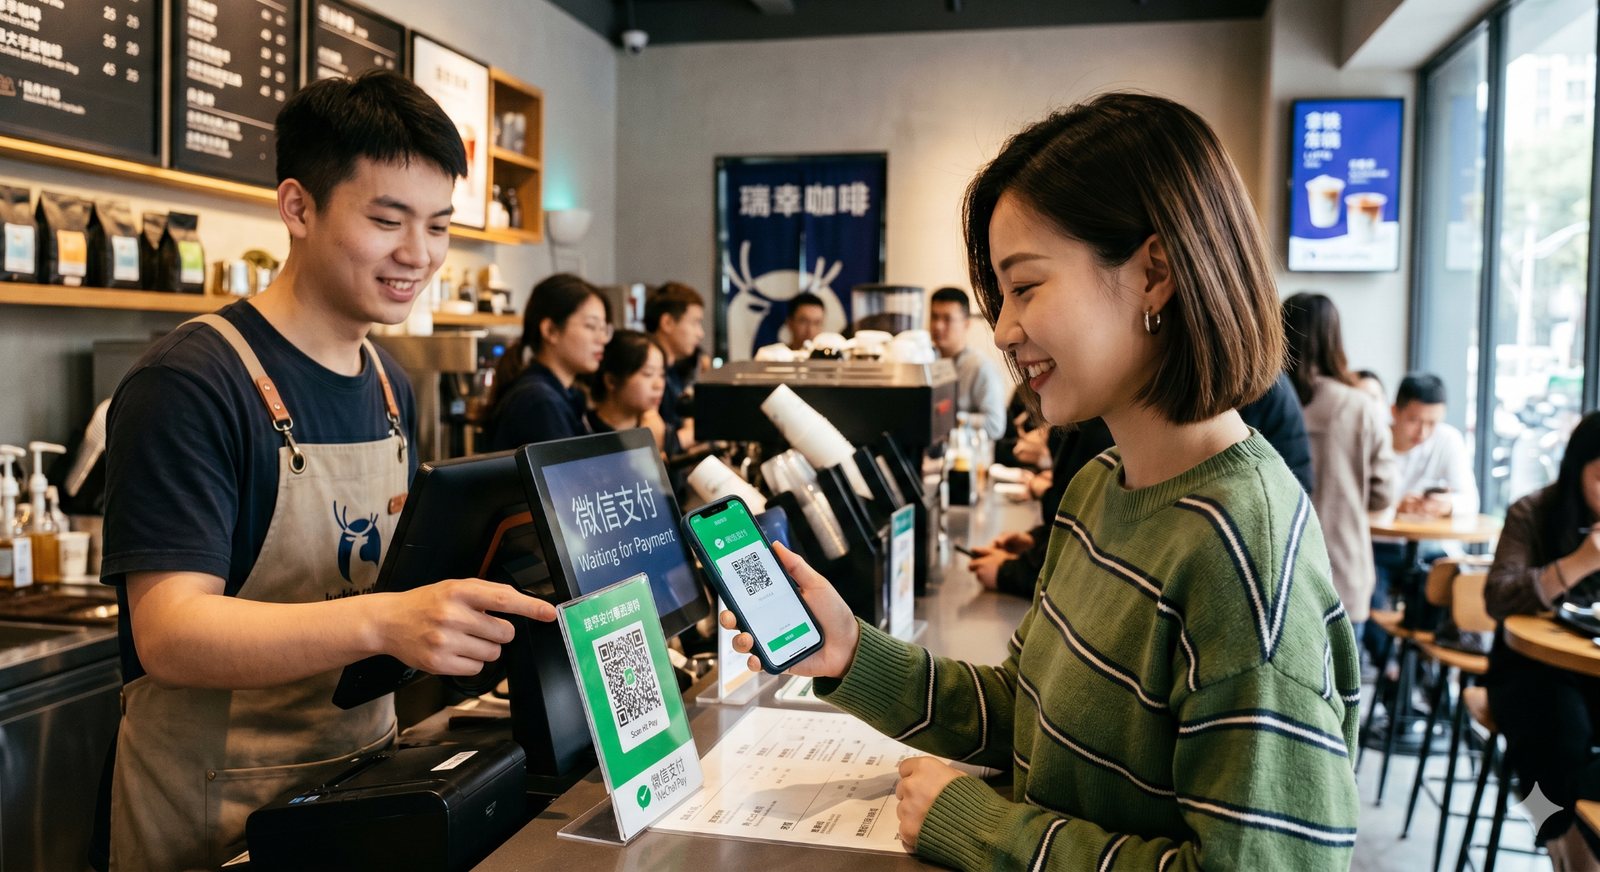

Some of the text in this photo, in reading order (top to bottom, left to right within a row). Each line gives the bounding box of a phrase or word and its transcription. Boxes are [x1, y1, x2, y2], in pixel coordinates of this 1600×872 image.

[739, 181, 870, 218] 瑞幸咖啡
[571, 479, 658, 540] 微信支付
[577, 528, 675, 572] Waiting for Payment
[651, 757, 685, 790] 微信支付
[676, 776, 688, 788] Pay
